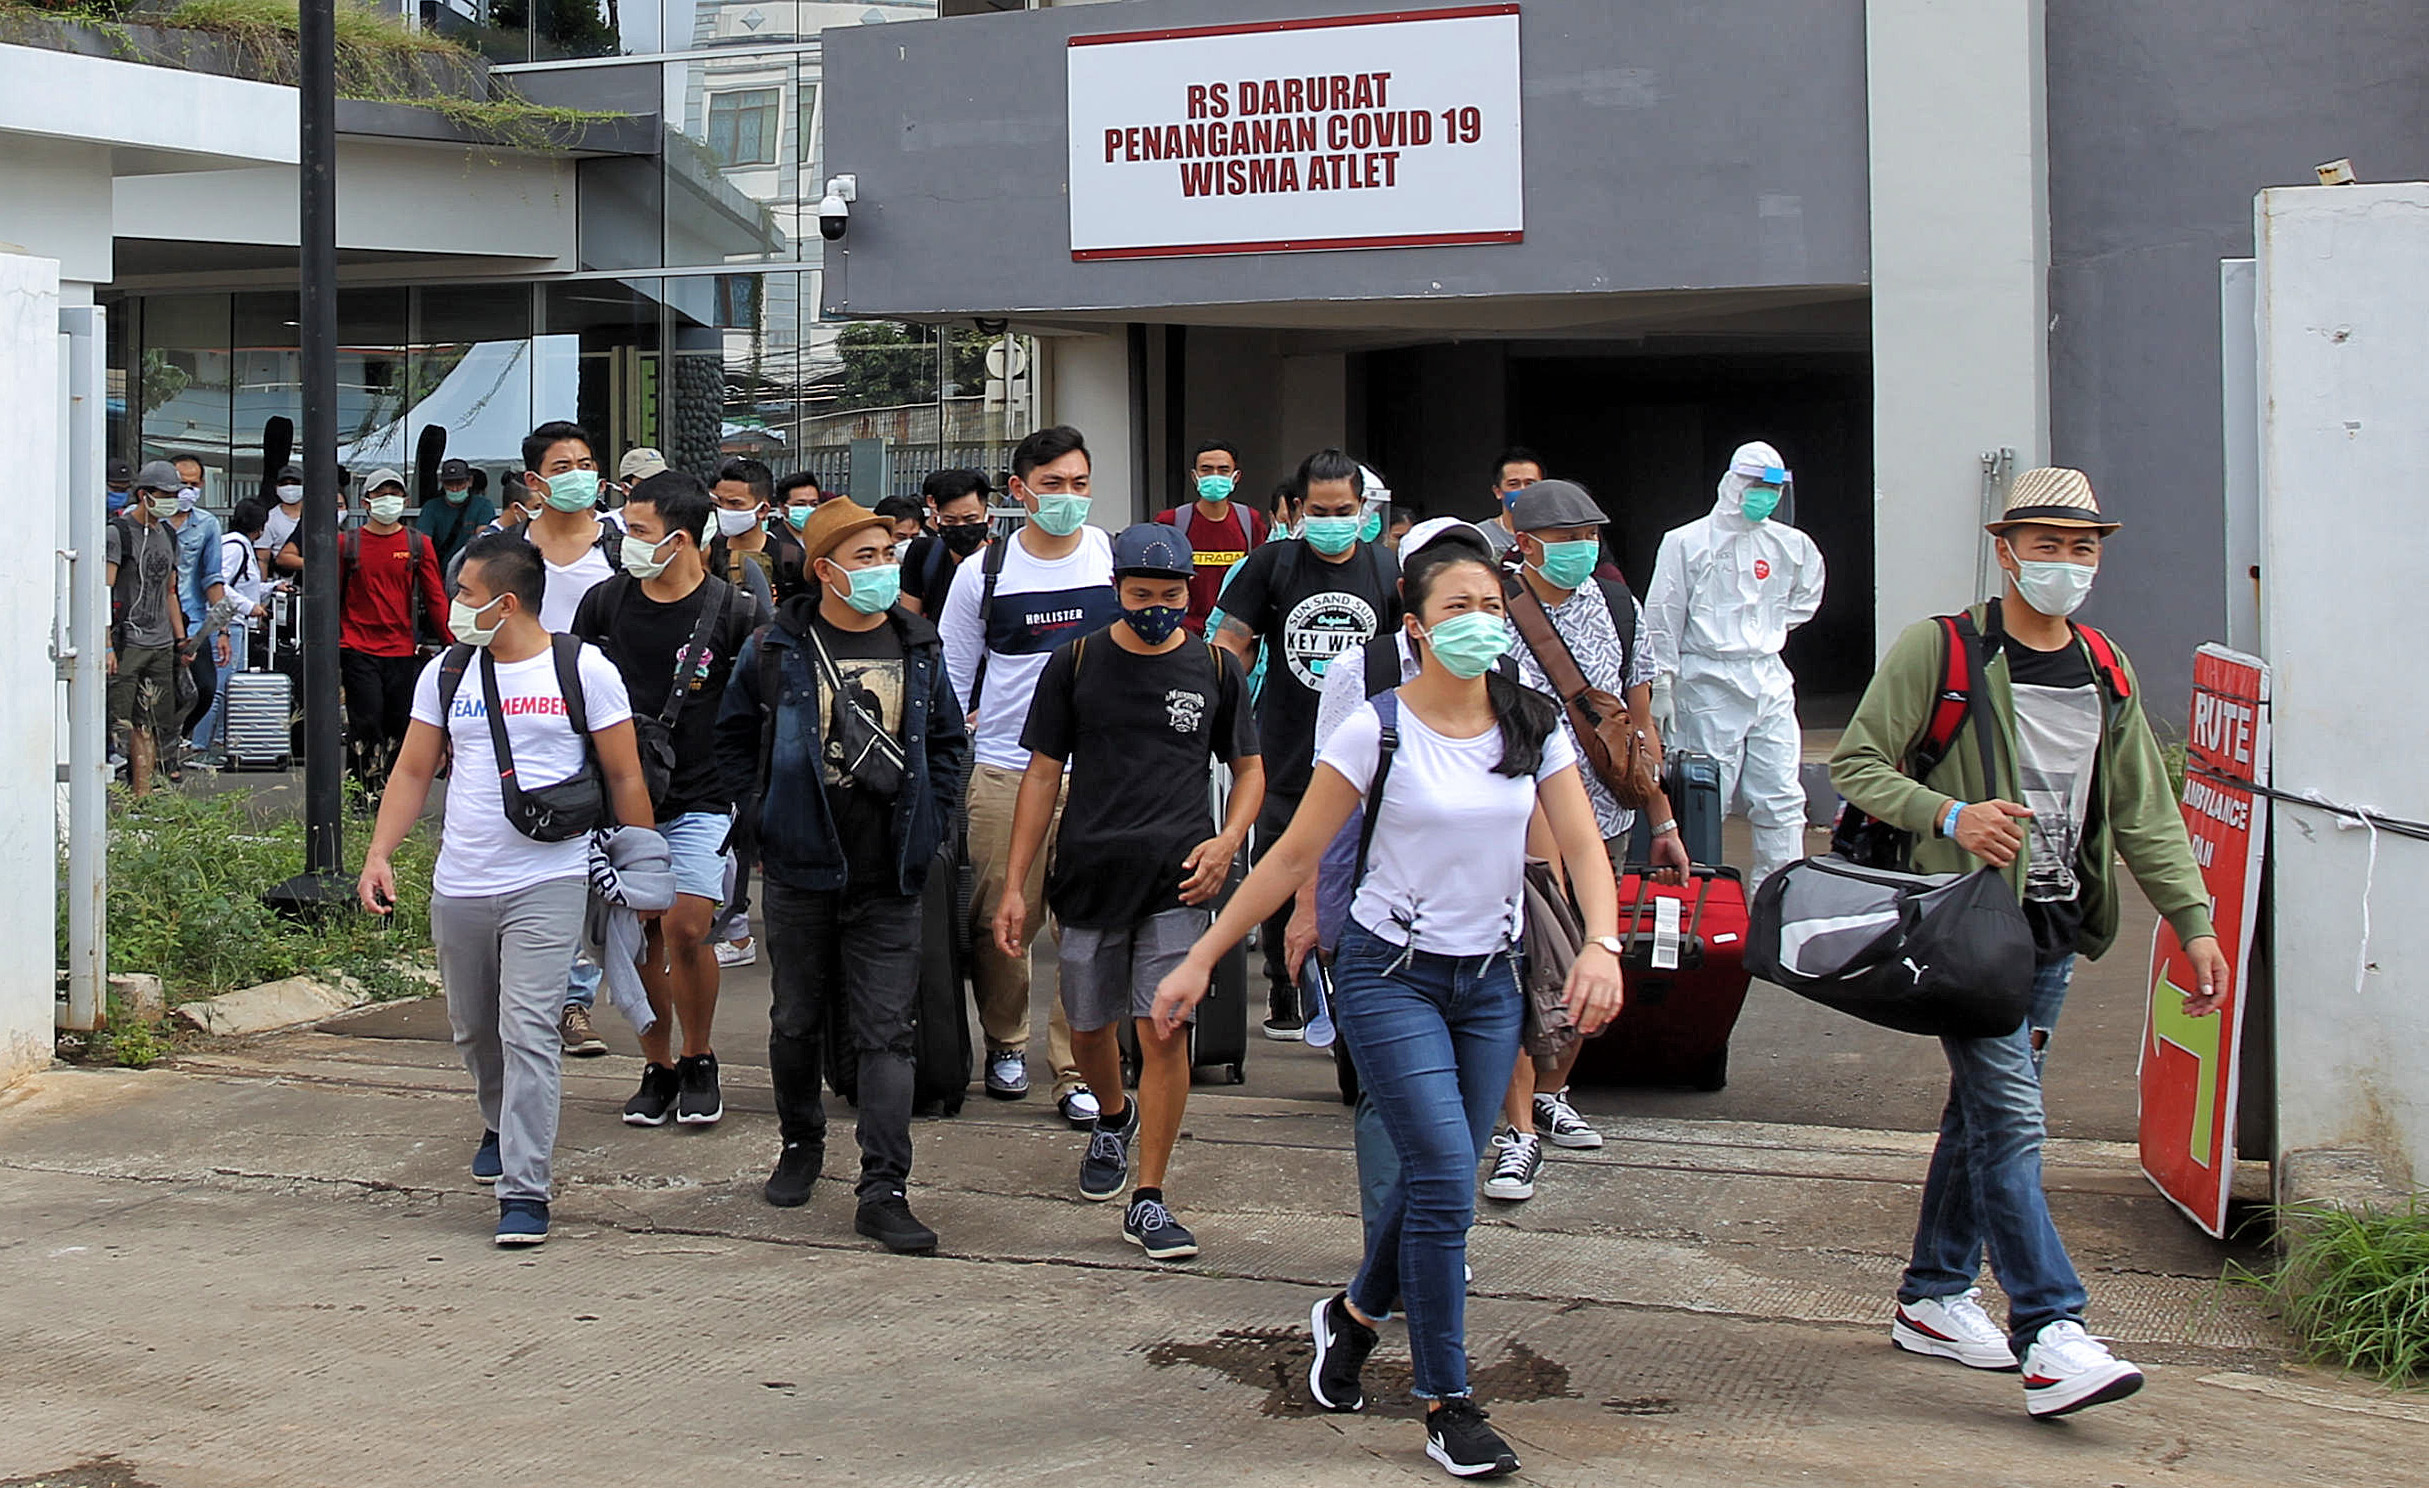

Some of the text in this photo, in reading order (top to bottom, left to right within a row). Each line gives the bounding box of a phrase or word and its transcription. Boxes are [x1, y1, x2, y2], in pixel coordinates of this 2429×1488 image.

[1187, 72, 1391, 120] RS DARURAT
[1104, 106, 1481, 163] PENANGANAN COVID 19
[1181, 152, 1400, 198] WISMA ATLET
[1025, 608, 1083, 625] HOLLISTER
[1287, 632, 1374, 652] KEY WES
[2193, 692, 2252, 764] RUTE
[2182, 779, 2248, 831] AMBULANCE
